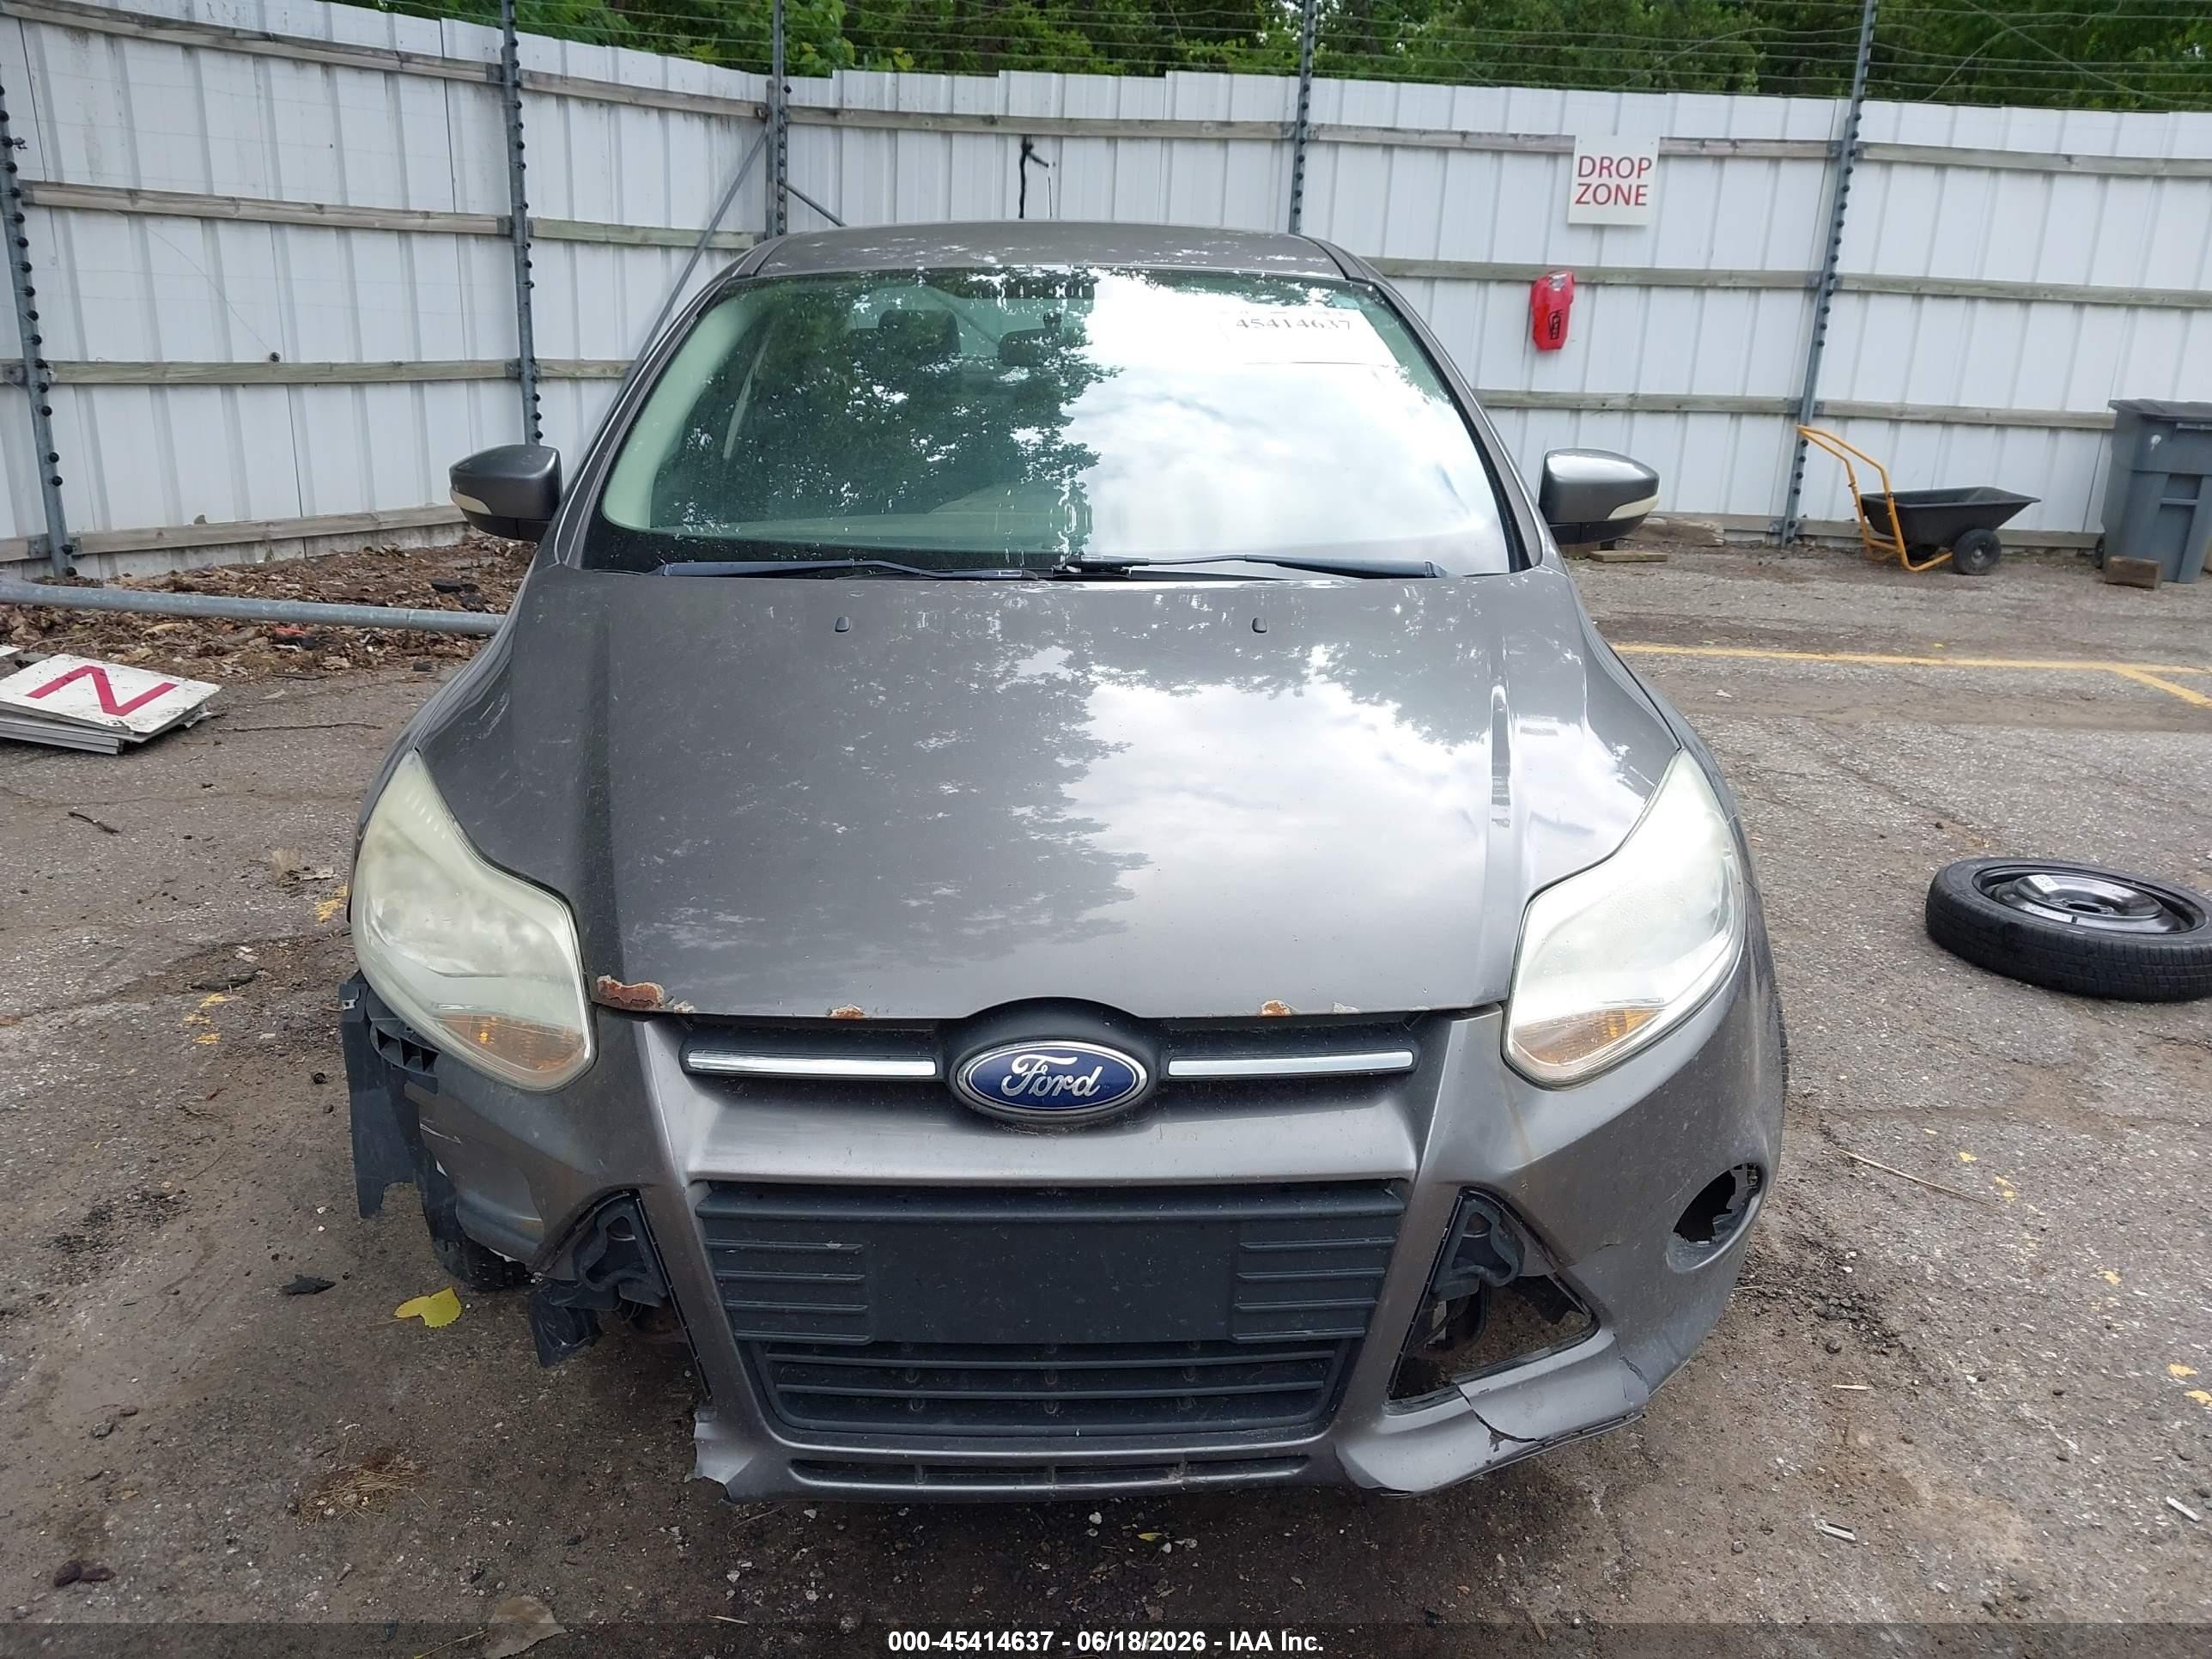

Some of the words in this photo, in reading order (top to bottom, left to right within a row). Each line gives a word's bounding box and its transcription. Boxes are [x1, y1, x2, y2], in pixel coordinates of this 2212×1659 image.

[1577, 155, 1652, 179] DROP
[1575, 183, 1649, 206] ZONE
[1236, 317, 1351, 331] 45414637
[1000, 1054, 1103, 1097] Ford
